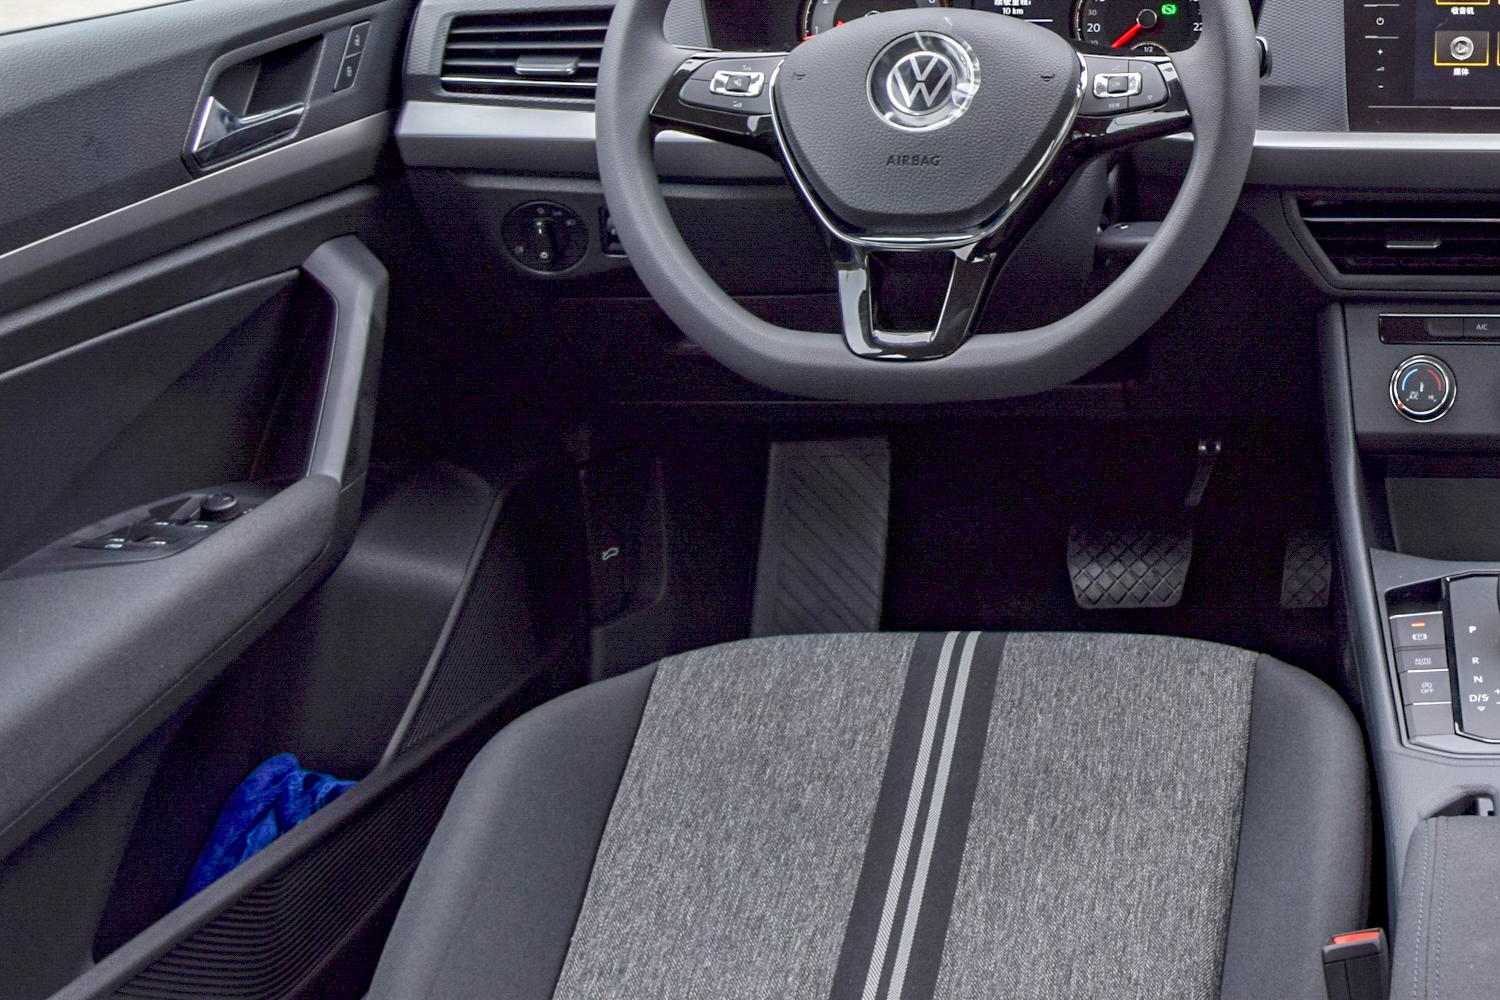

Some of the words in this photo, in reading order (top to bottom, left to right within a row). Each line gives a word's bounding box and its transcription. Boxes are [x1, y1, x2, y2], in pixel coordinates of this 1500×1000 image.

[1002, 7, 1011, 15] 10
[1012, 7, 1024, 15] km
[1087, 23, 1101, 32] 20
[886, 155, 941, 167] AIRBAG
[1475, 322, 1488, 332] A/C
[1469, 625, 1477, 633] P
[1474, 675, 1483, 683] N
[1468, 692, 1489, 703] D/S
